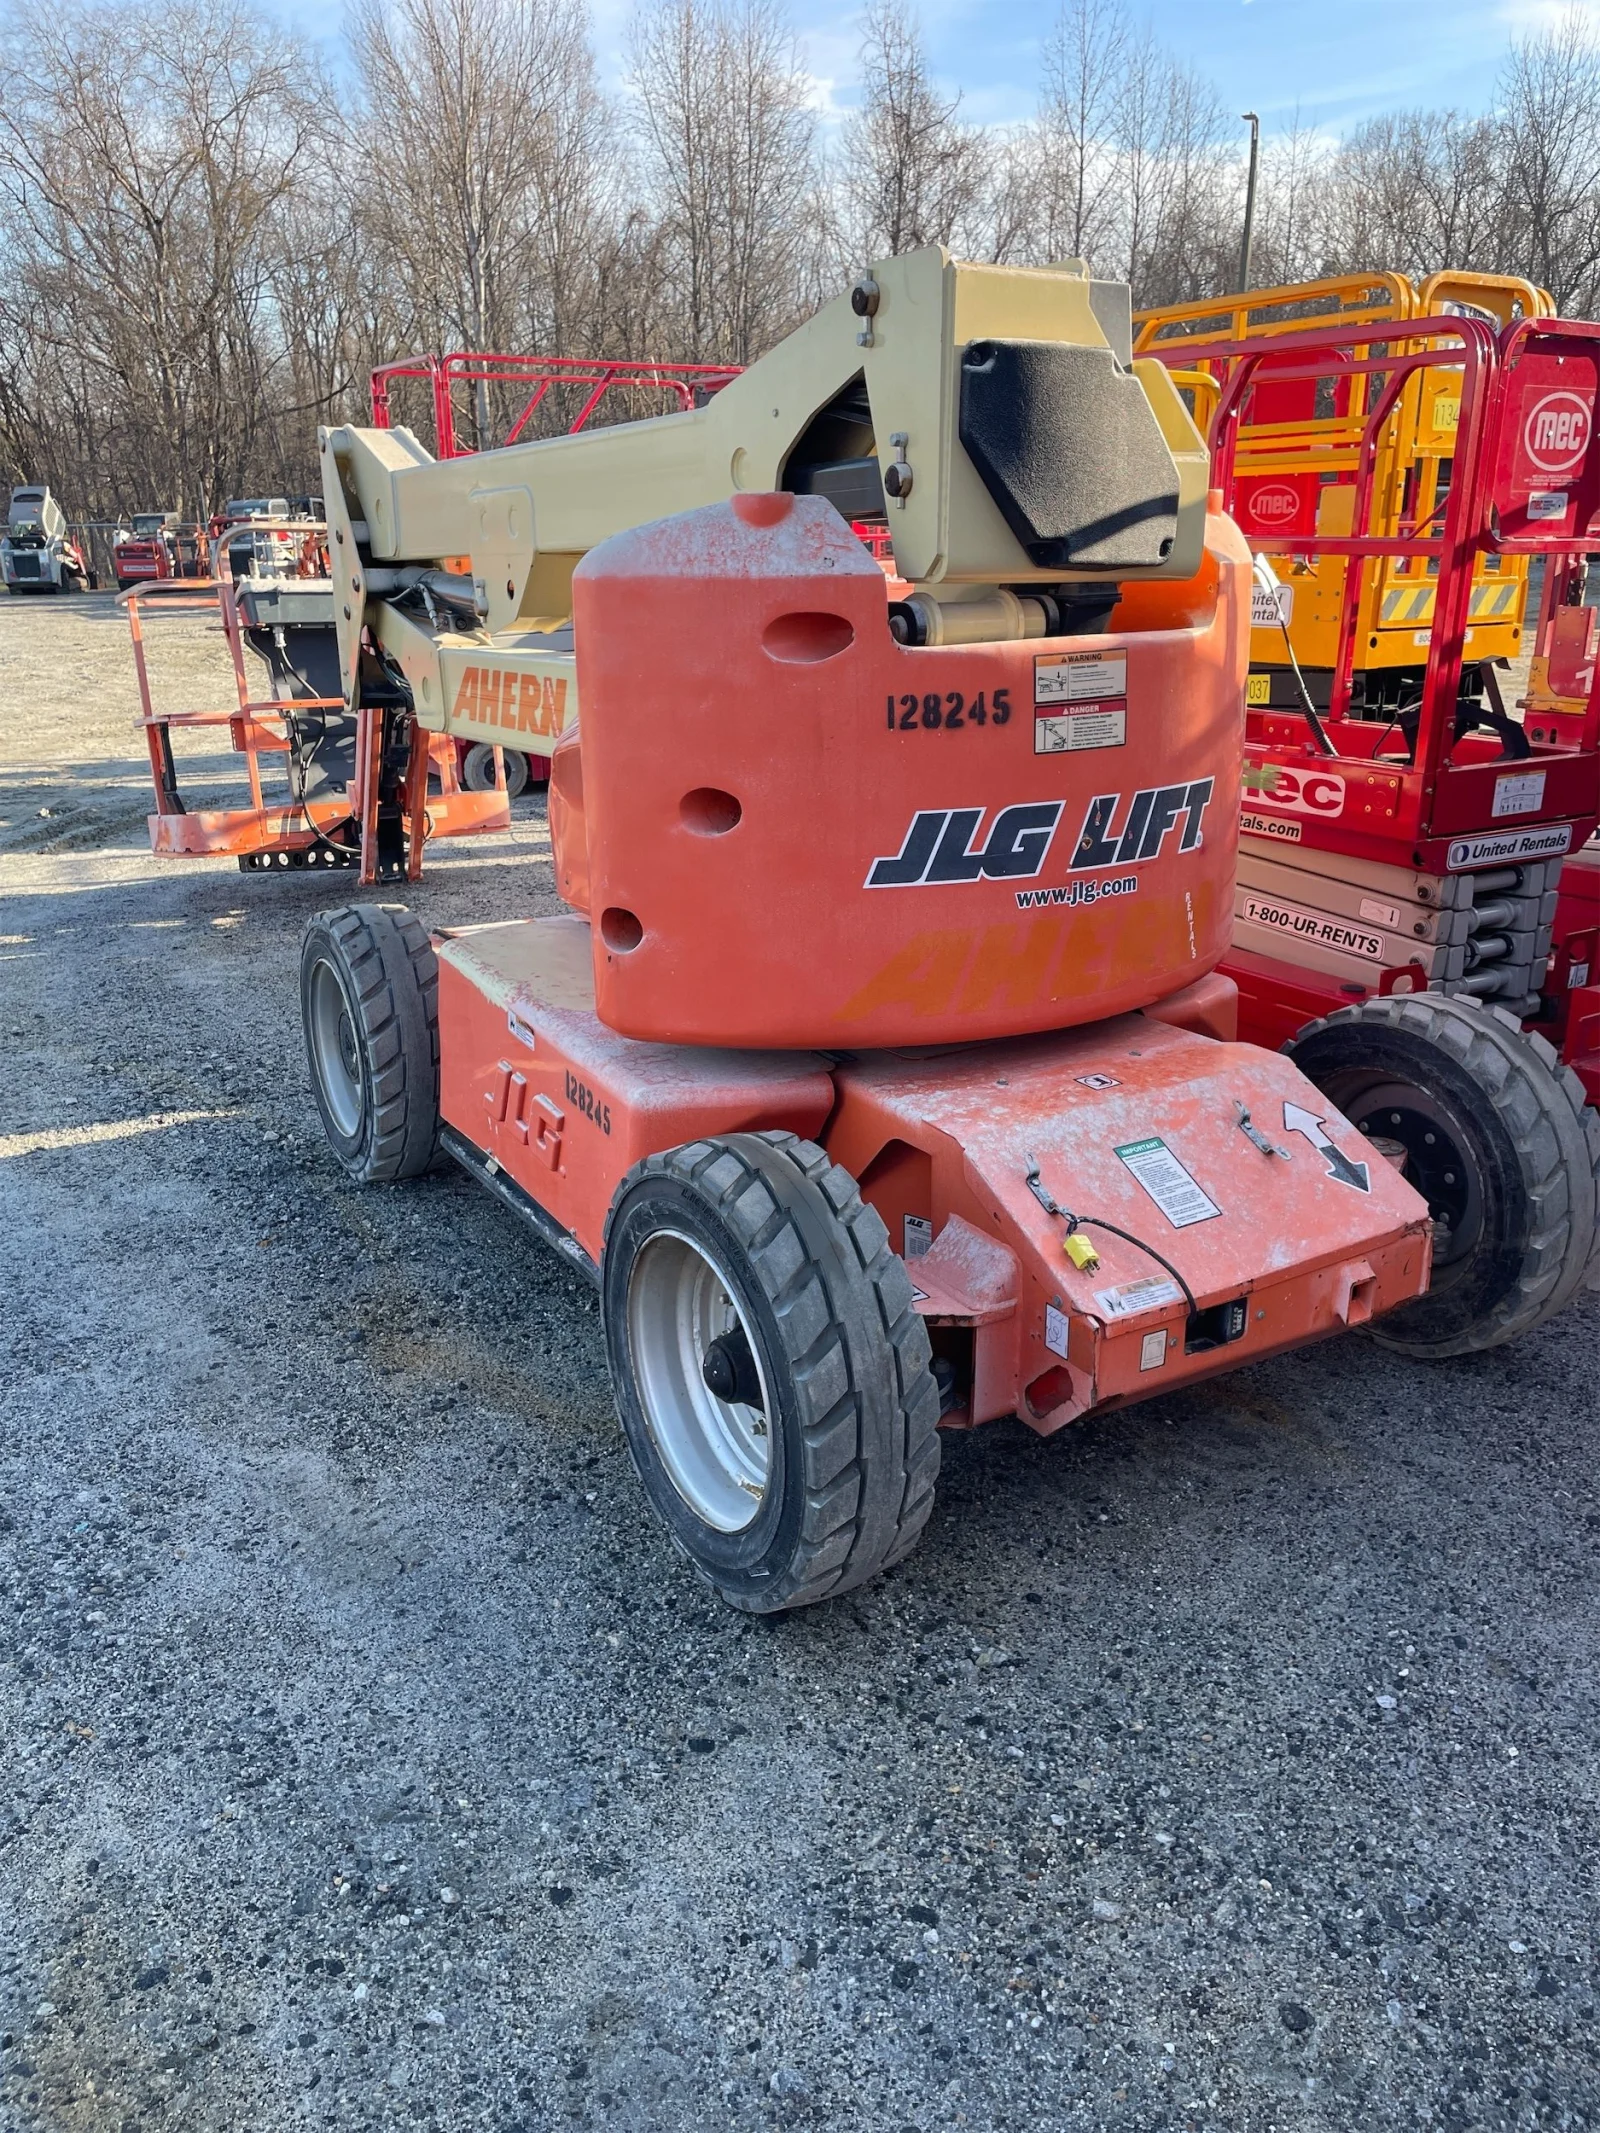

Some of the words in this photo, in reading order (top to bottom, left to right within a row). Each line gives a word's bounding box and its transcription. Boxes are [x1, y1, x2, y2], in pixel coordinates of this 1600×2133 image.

[1251, 592, 1284, 606] nited
[1067, 653, 1103, 663] WARNING
[452, 666, 568, 739] AHERN
[1247, 679, 1269, 699] 037
[886, 688, 1011, 730] 128245
[1069, 705, 1100, 715] DANGER
[863, 800, 1067, 889] JLG
[1067, 775, 1216, 874] LIFT
[1240, 815, 1300, 838] tals.com
[1472, 839, 1518, 859] United
[1518, 832, 1568, 853] Rentals
[1015, 875, 1138, 909] www.jlg.com
[1185, 892, 1197, 960] RENTALS
[1248, 903, 1380, 955] 1-800-UR-RENTS
[483, 1056, 565, 1173] JLG
[565, 1067, 612, 1137] 128245
[1120, 1140, 1160, 1156] IMPORTANT
[906, 1217, 924, 1229] JLG
